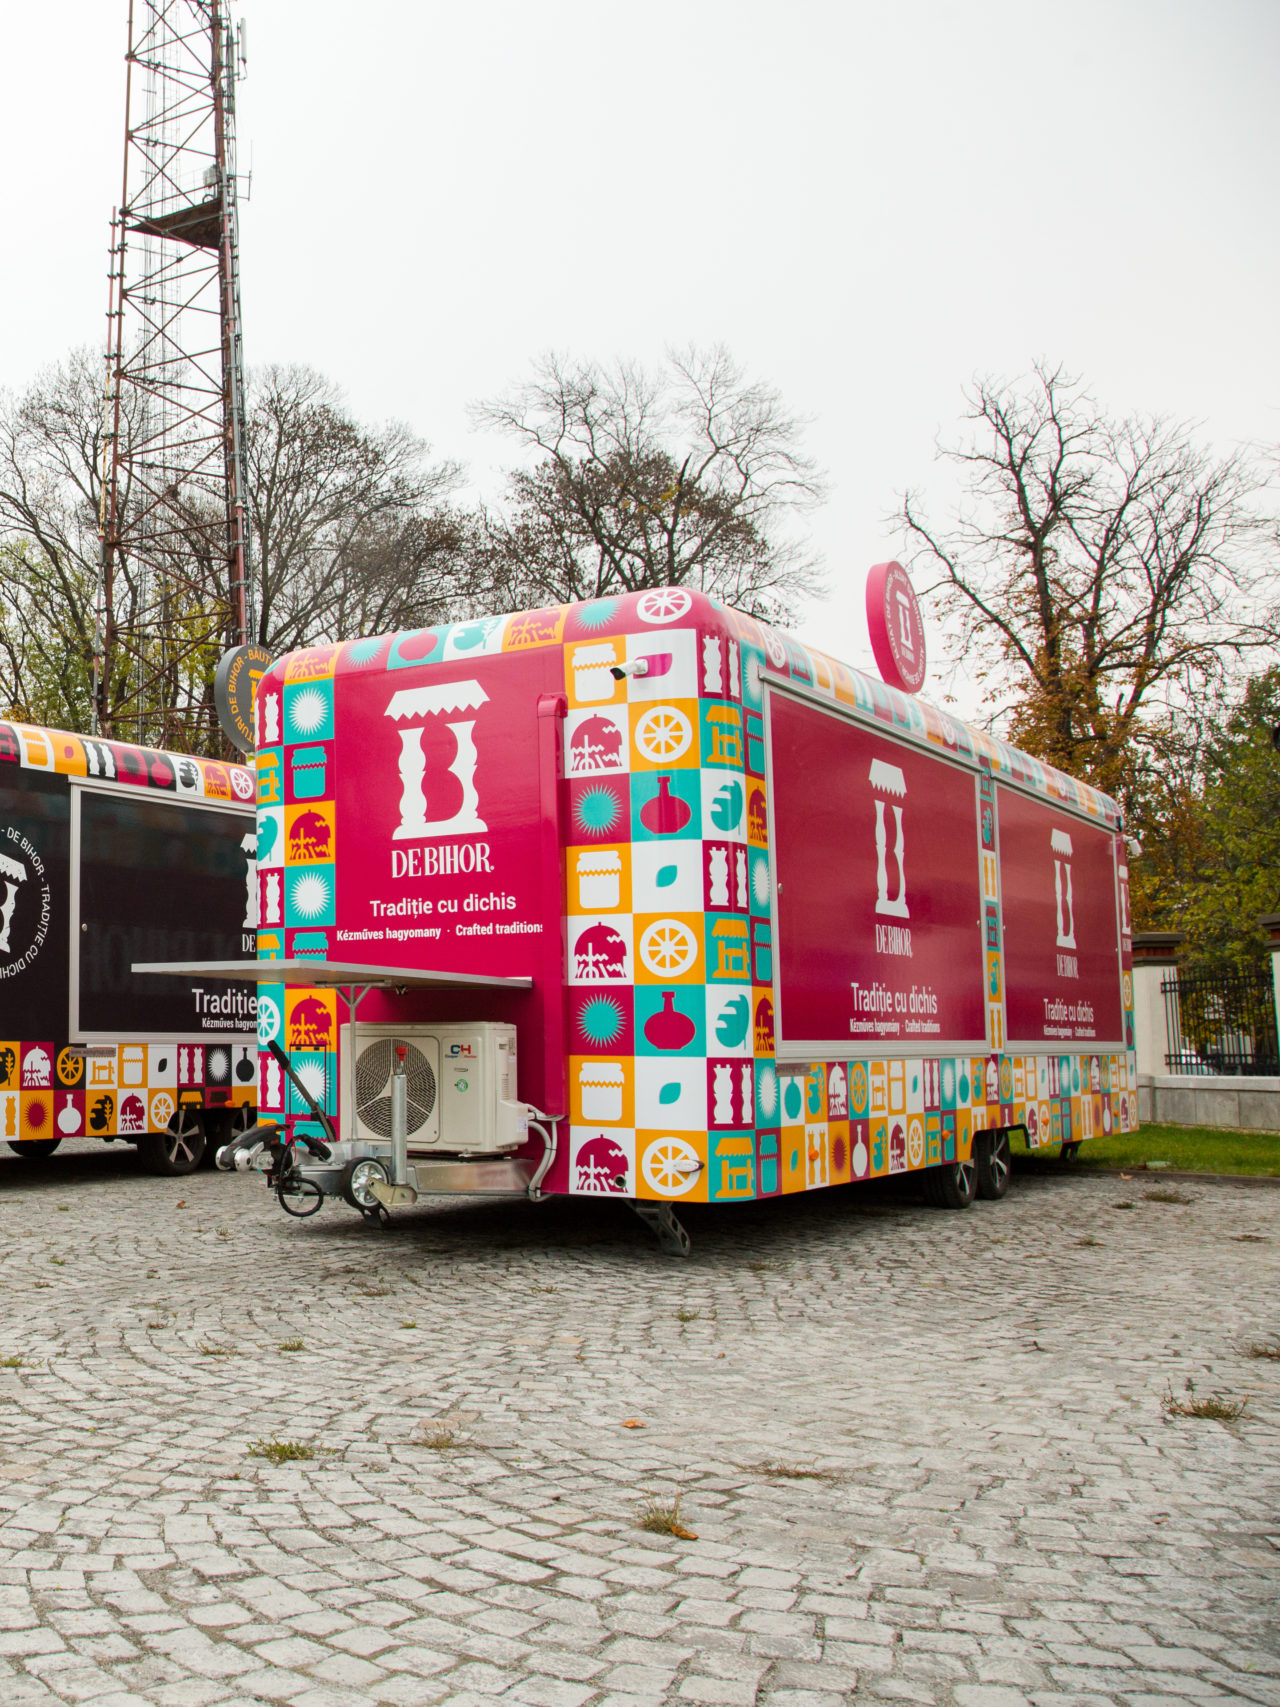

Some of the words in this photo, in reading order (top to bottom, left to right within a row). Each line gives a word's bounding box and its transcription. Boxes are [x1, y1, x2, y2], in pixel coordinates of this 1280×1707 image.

[228, 656, 245, 694] BIHOR
[7, 827, 21, 843] DE
[20, 837, 45, 876] BIHOR
[370, 897, 433, 919] Tradiție
[437, 898, 458, 913] cu
[462, 891, 516, 911] dichis
[242, 934, 256, 952] DE
[336, 928, 384, 941] Kézműves
[455, 923, 493, 936] Crafted
[191, 988, 257, 1018] Tradiție
[894, 991, 907, 1013] cu
[908, 985, 937, 1014] dichis
[450, 1043, 472, 1055] CH
